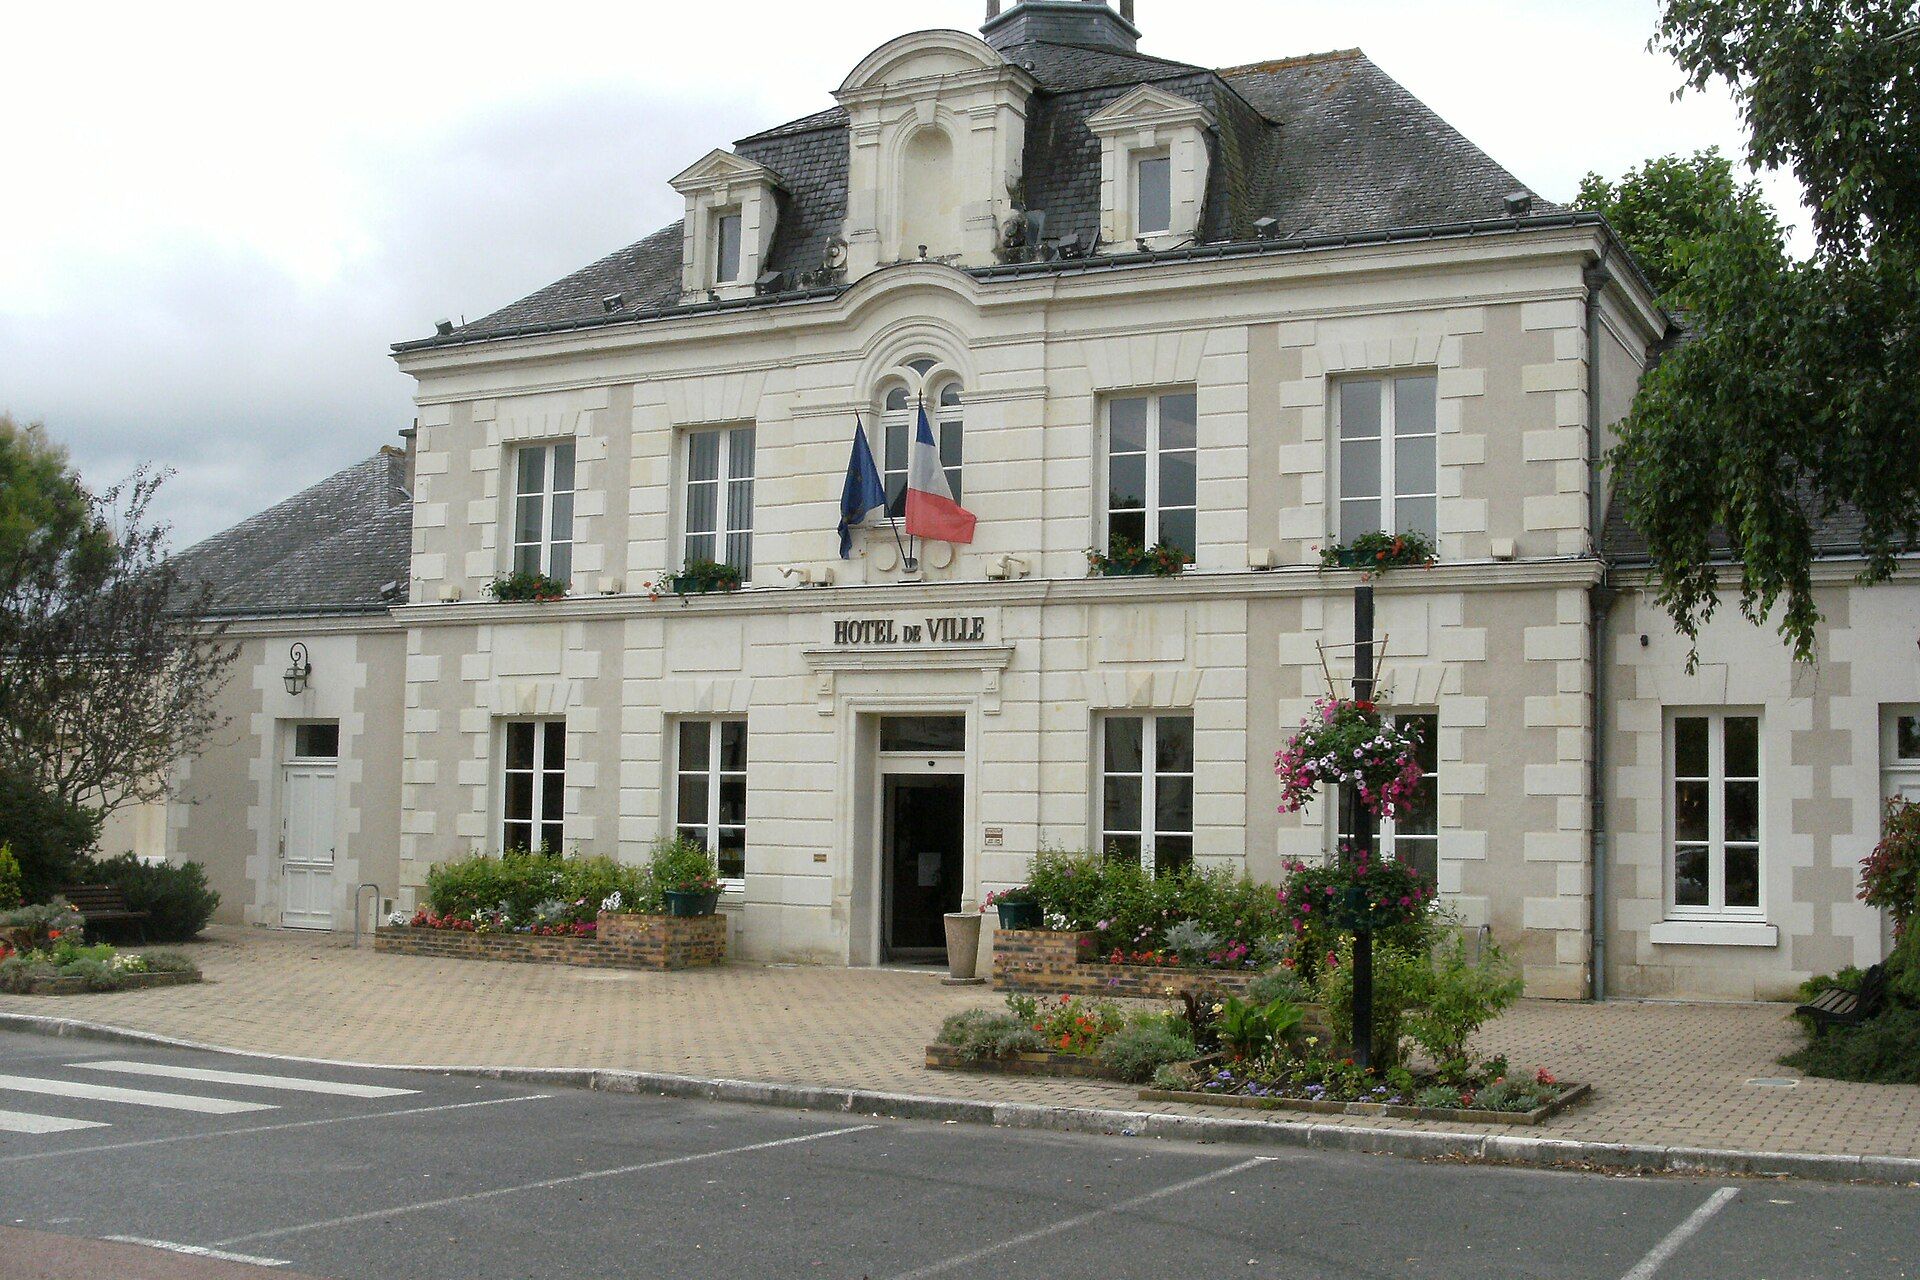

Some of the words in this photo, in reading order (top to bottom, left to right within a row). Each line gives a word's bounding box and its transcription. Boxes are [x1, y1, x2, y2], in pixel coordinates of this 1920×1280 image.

[834, 619, 898, 644] HOTEL
[902, 625, 921, 642] DE
[925, 617, 984, 642] VILLE
